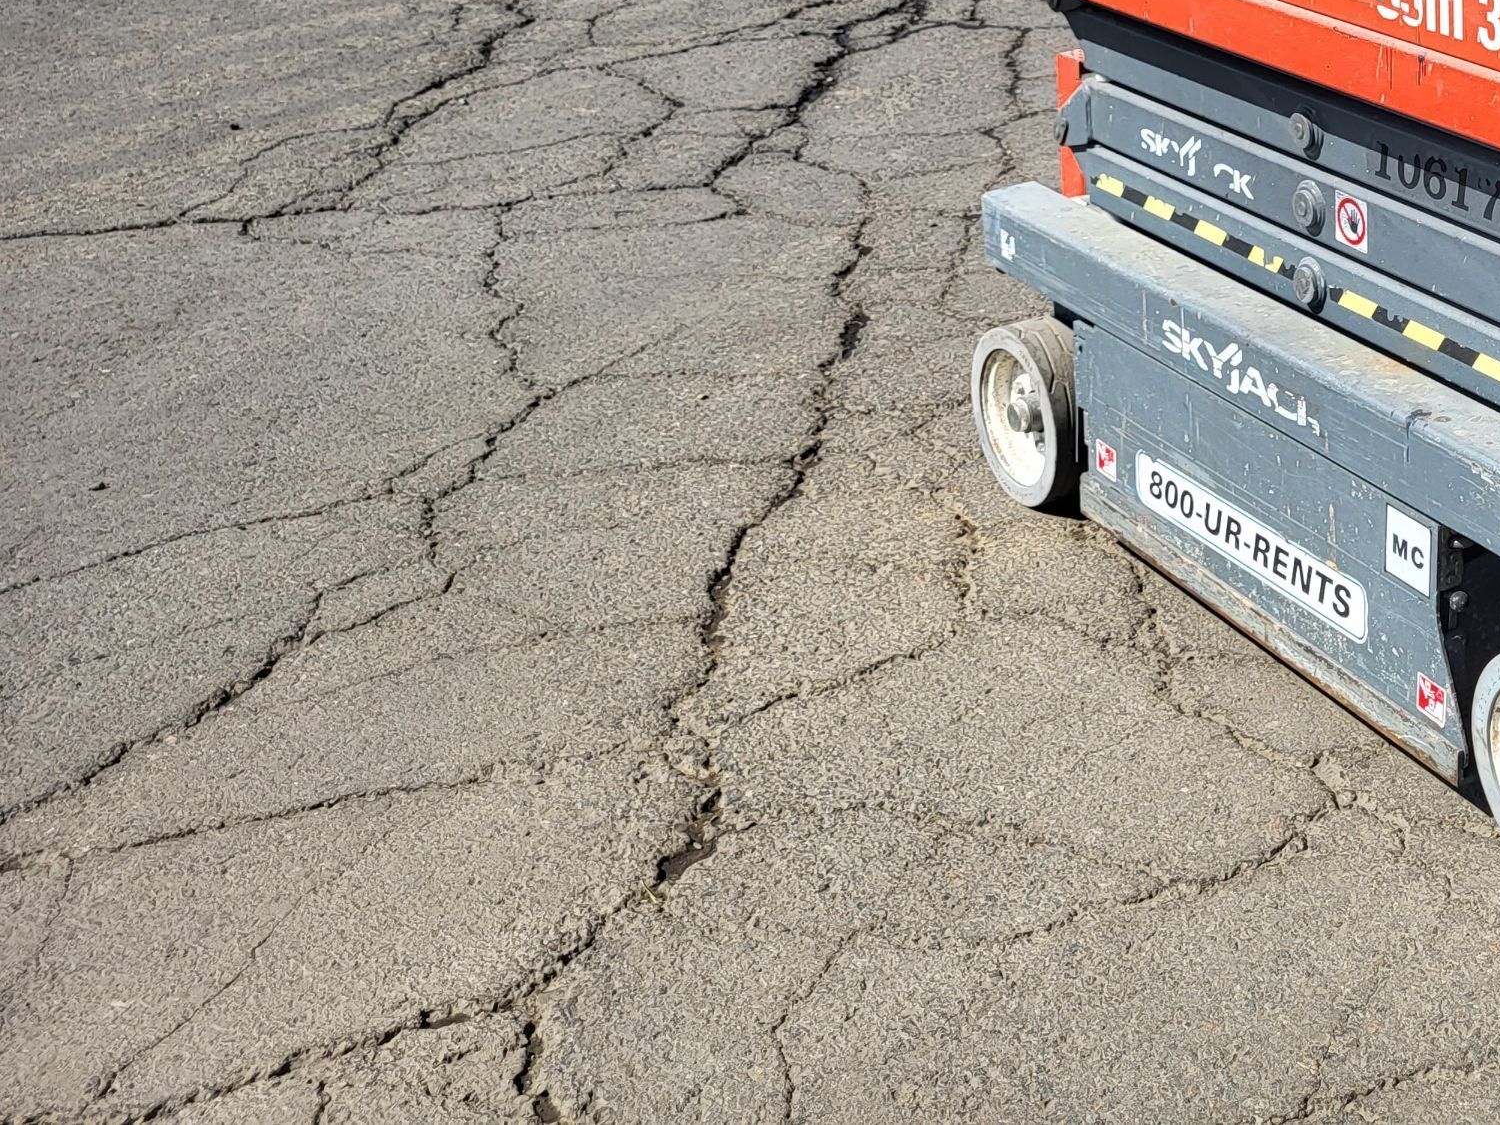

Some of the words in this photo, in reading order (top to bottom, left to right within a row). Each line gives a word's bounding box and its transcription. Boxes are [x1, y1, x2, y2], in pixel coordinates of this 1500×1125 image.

[1140, 128, 1255, 200] SKYJCK
[1149, 470, 1352, 618] 800-UR-RENTS
[1392, 533, 1425, 570] MC
